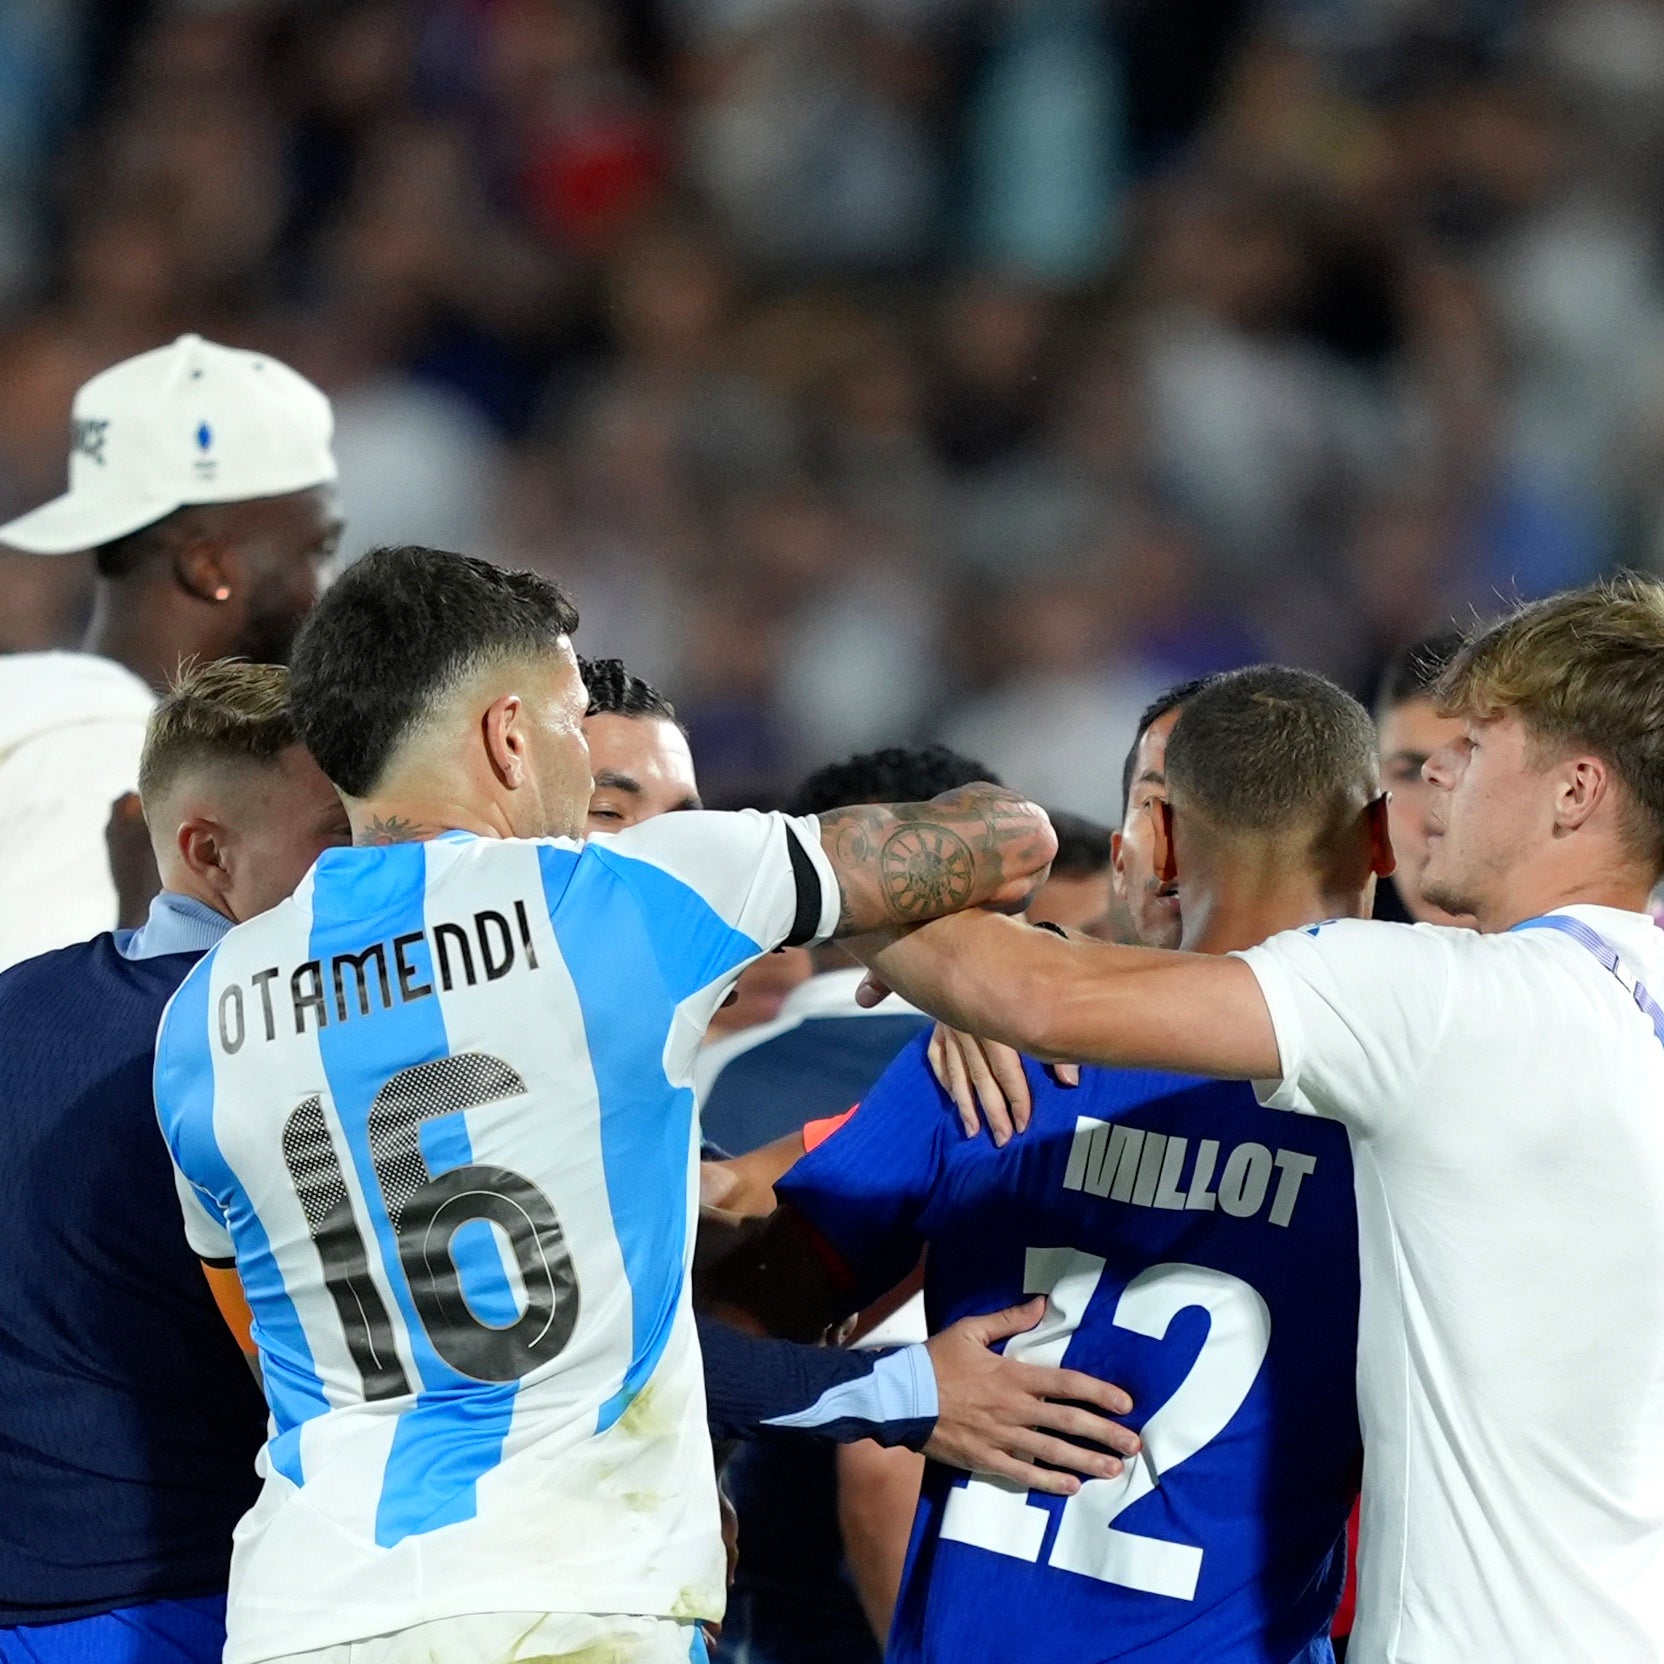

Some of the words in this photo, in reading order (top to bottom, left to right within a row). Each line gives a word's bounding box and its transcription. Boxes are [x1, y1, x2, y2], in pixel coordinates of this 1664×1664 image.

[217, 900, 540, 1056] OTAMENDI
[280, 1050, 583, 1402] 16
[1062, 1115, 1318, 1228] MILLOT
[938, 1246, 1272, 1602] 12
